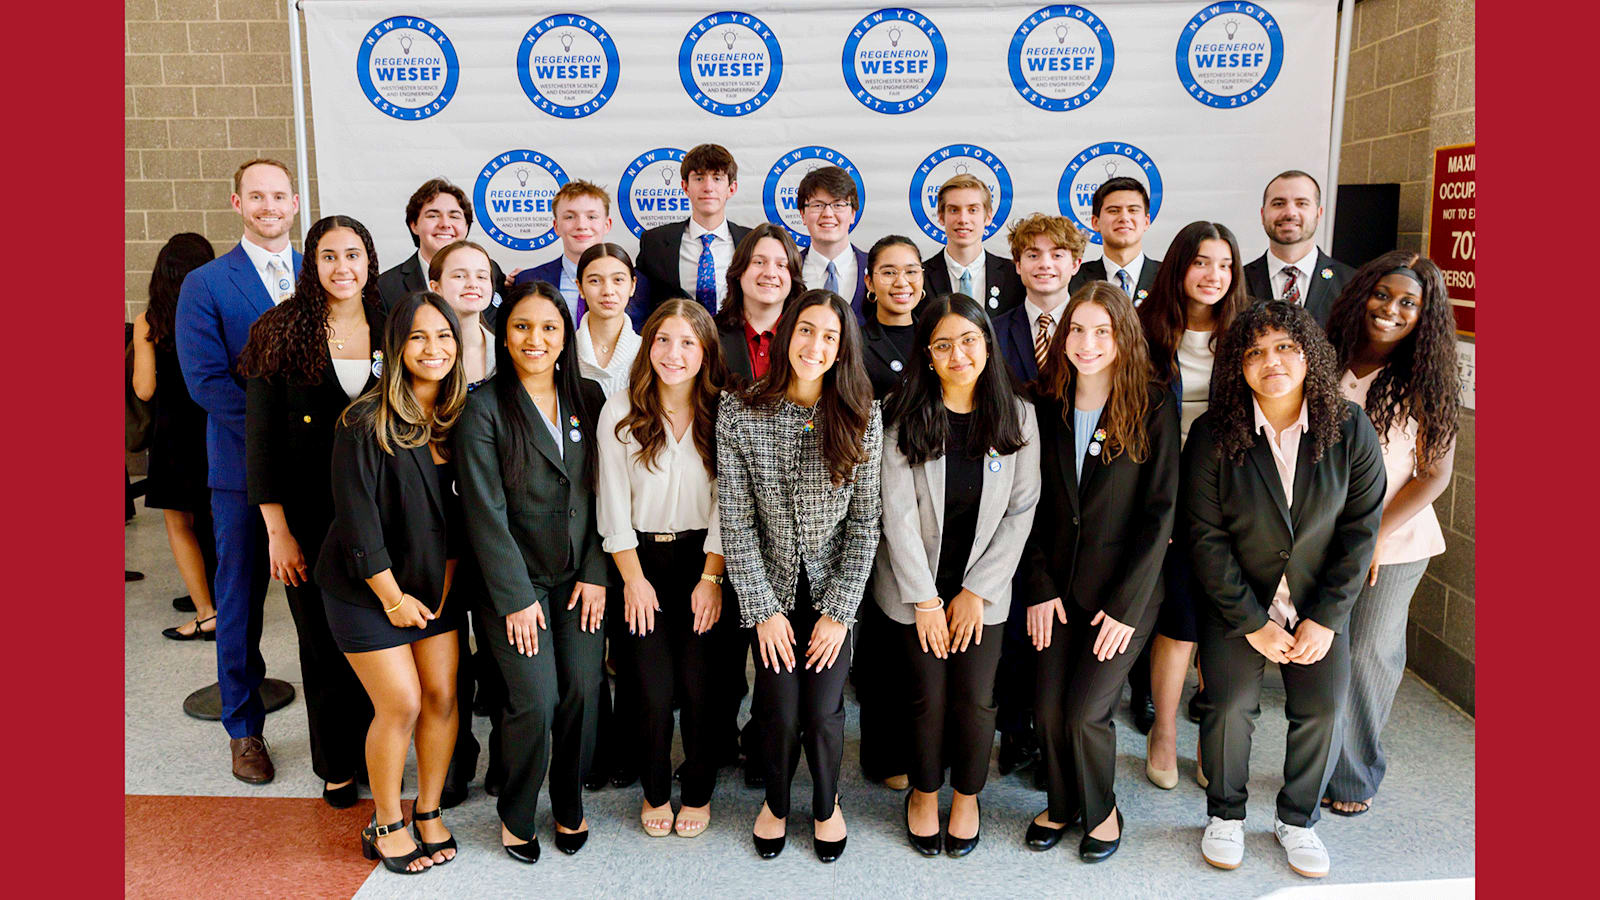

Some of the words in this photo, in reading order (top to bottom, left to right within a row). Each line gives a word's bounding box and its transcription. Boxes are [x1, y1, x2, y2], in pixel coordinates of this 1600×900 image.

[690, 16, 717, 41] NEW
[731, 14, 770, 39] YORK
[854, 13, 882, 38] NEW
[896, 11, 935, 36] YORK
[1021, 10, 1050, 35] NEW
[1064, 7, 1103, 33] YORK
[1190, 6, 1219, 31] NEW
[1234, 3, 1274, 29] YORK
[366, 21, 394, 45] NEW
[407, 19, 446, 44] YORK
[527, 18, 554, 43] NEW
[568, 16, 607, 42] YORK
[697, 53, 764, 61] REGENERON
[860, 50, 928, 58] REGENERON
[1026, 47, 1095, 55] REGENERON
[1195, 43, 1264, 52] REGENERON
[698, 63, 764, 76] WESEF
[861, 60, 928, 74] WESEF
[1027, 57, 1094, 71] WESEF
[1196, 53, 1264, 68] WESEF
[376, 68, 440, 81] WESEF
[536, 65, 601, 79] WESEF
[533, 94, 562, 115] EST.
[574, 94, 606, 116] 2001
[694, 92, 723, 113] EST.
[735, 92, 768, 114] 2001
[858, 90, 886, 111] EST.
[898, 89, 932, 111] 2001
[1022, 87, 1052, 108] EST.
[1064, 86, 1098, 108] 2001
[1190, 84, 1218, 105] EST.
[1231, 83, 1267, 106] 2001
[374, 96, 403, 117] EST.
[415, 96, 447, 118] 2001
[483, 154, 510, 178] NEW
[523, 152, 561, 177] YORK
[628, 153, 655, 176] NEW
[668, 151, 687, 161] YO
[774, 151, 802, 175] NEW
[815, 149, 853, 173] YORK
[921, 149, 950, 173] NEW
[963, 147, 1002, 172] YORK
[1070, 147, 1100, 171] NEW
[1114, 144, 1152, 170] YORK
[1448, 154, 1475, 173] MAXI
[490, 190, 556, 198] REGENERON
[1440, 181, 1475, 200] OCCUP
[636, 198, 690, 211] WESE
[1443, 209, 1456, 220] NOT
[1458, 208, 1467, 220] TO
[1469, 208, 1475, 219] E
[489, 227, 518, 248] EST.
[530, 233, 554, 248] 200
[924, 223, 947, 241] EST
[984, 223, 997, 236] 01
[1441, 270, 1475, 288] PERSO
